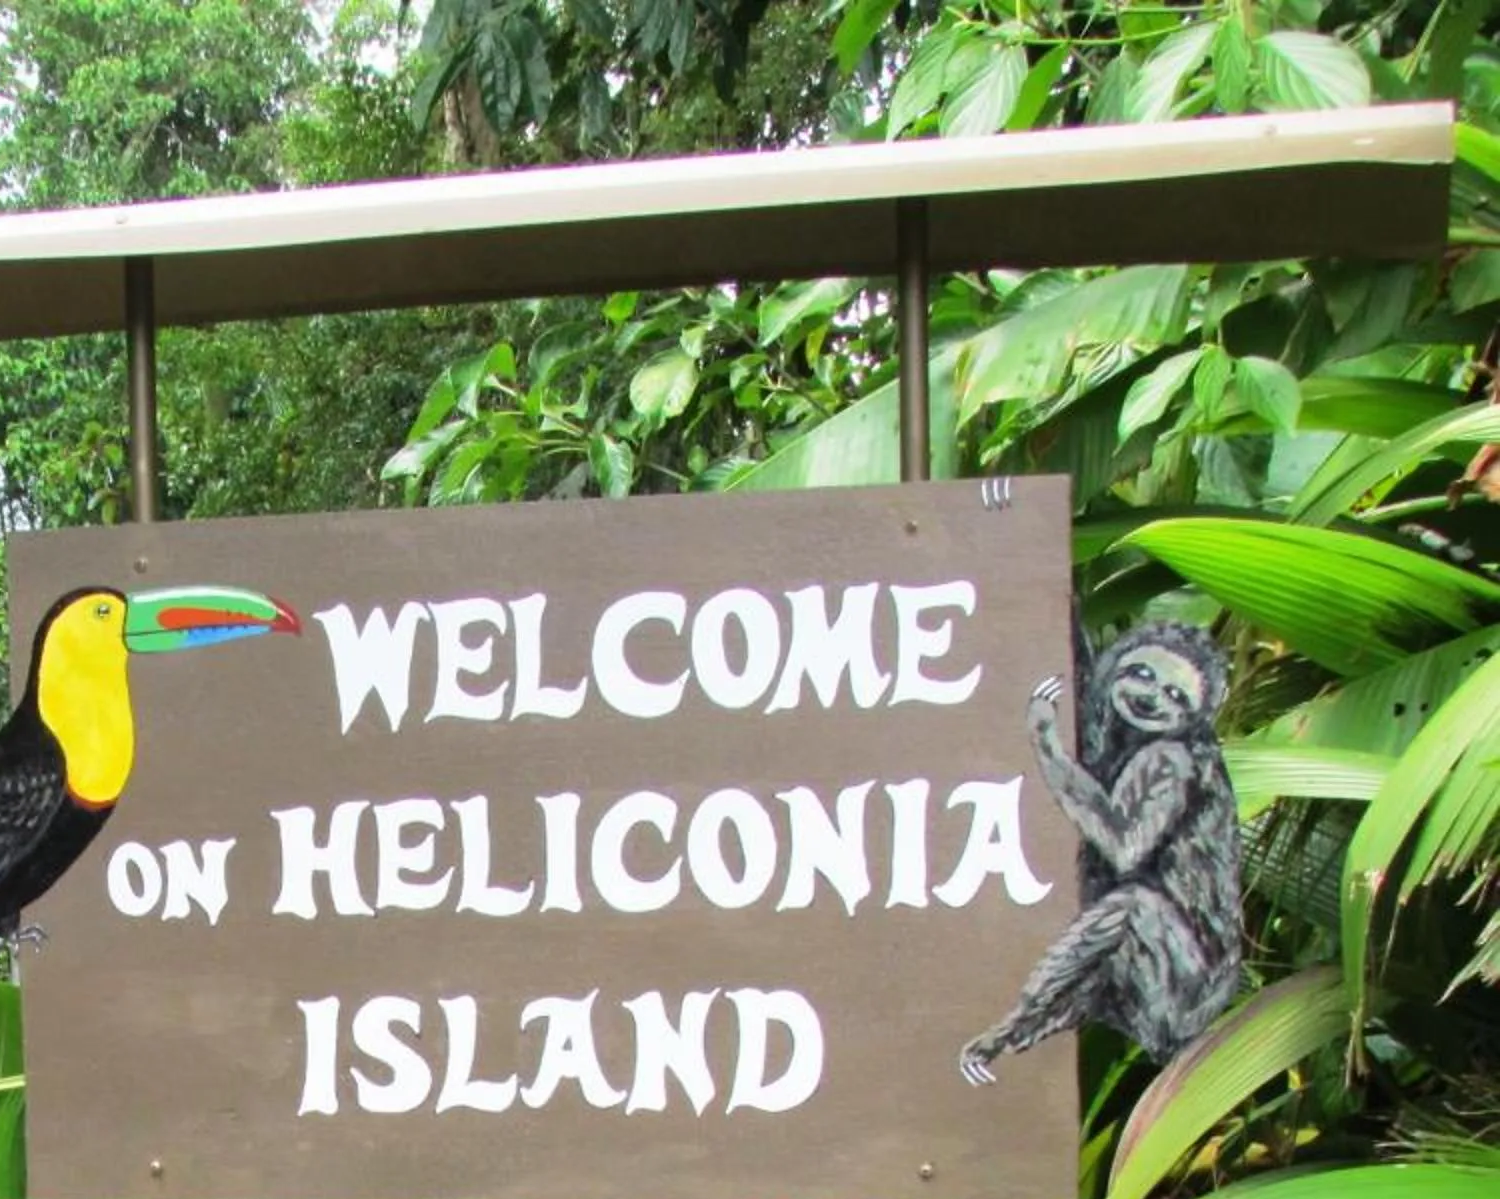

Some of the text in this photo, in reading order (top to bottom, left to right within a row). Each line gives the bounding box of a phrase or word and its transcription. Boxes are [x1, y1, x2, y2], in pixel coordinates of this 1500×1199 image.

[311, 579, 984, 735] WELCOME
[106, 775, 1055, 926] ON HELICONIA
[297, 987, 826, 1117] ISLAND
